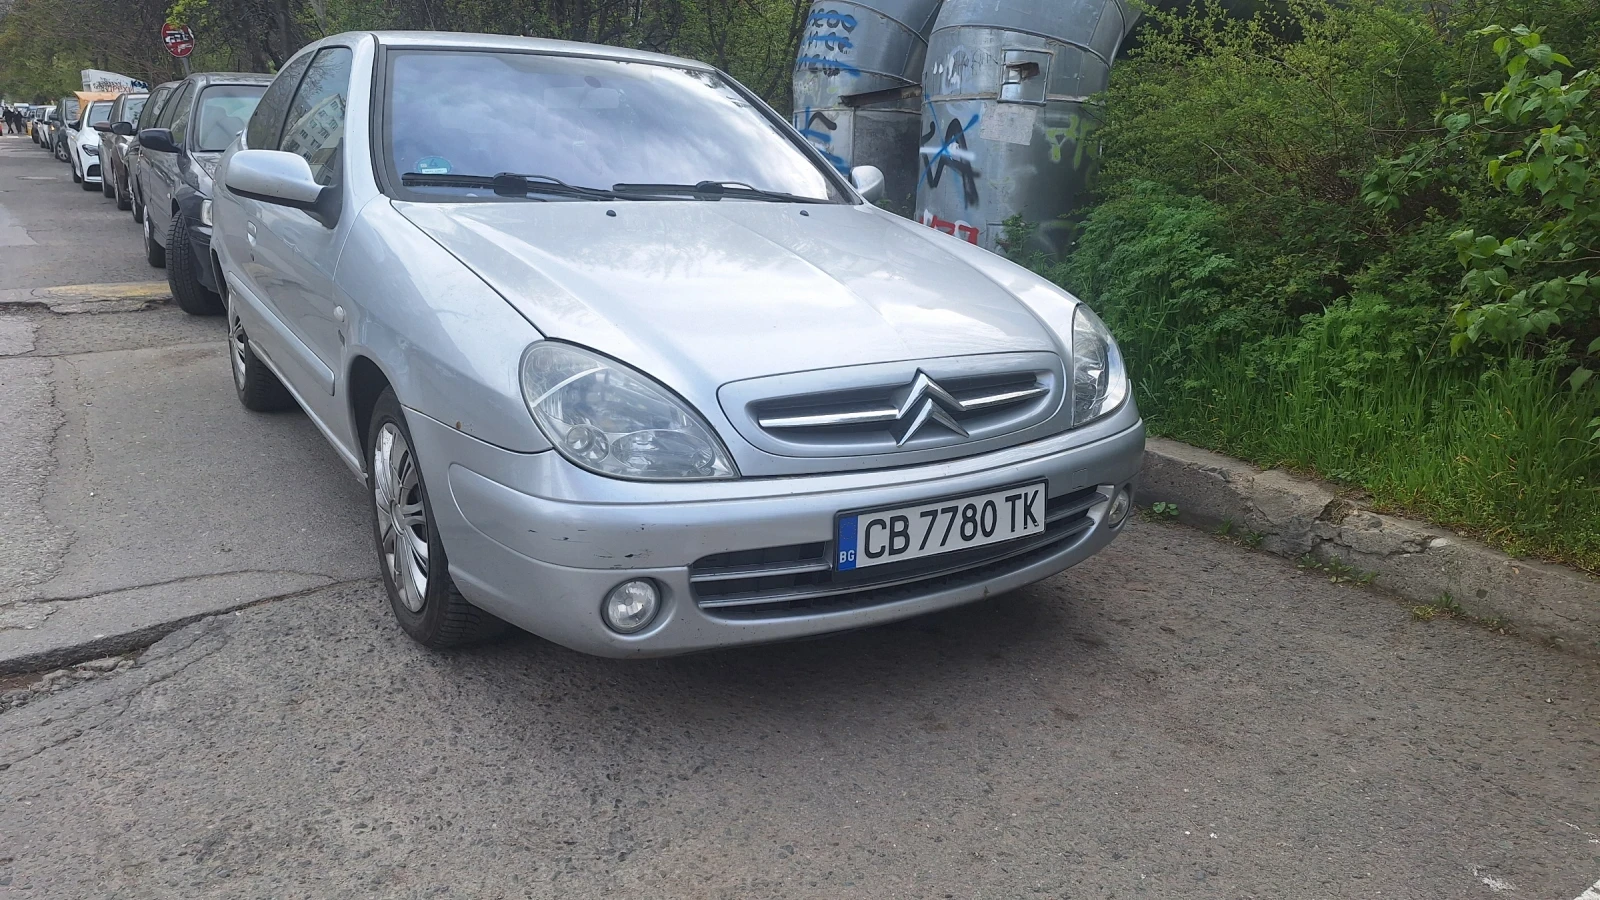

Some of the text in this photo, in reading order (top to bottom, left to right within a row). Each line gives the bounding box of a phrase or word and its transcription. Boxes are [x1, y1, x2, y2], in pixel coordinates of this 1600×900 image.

[864, 489, 1040, 559] CB 7780 TK
[839, 550, 855, 563] BG
